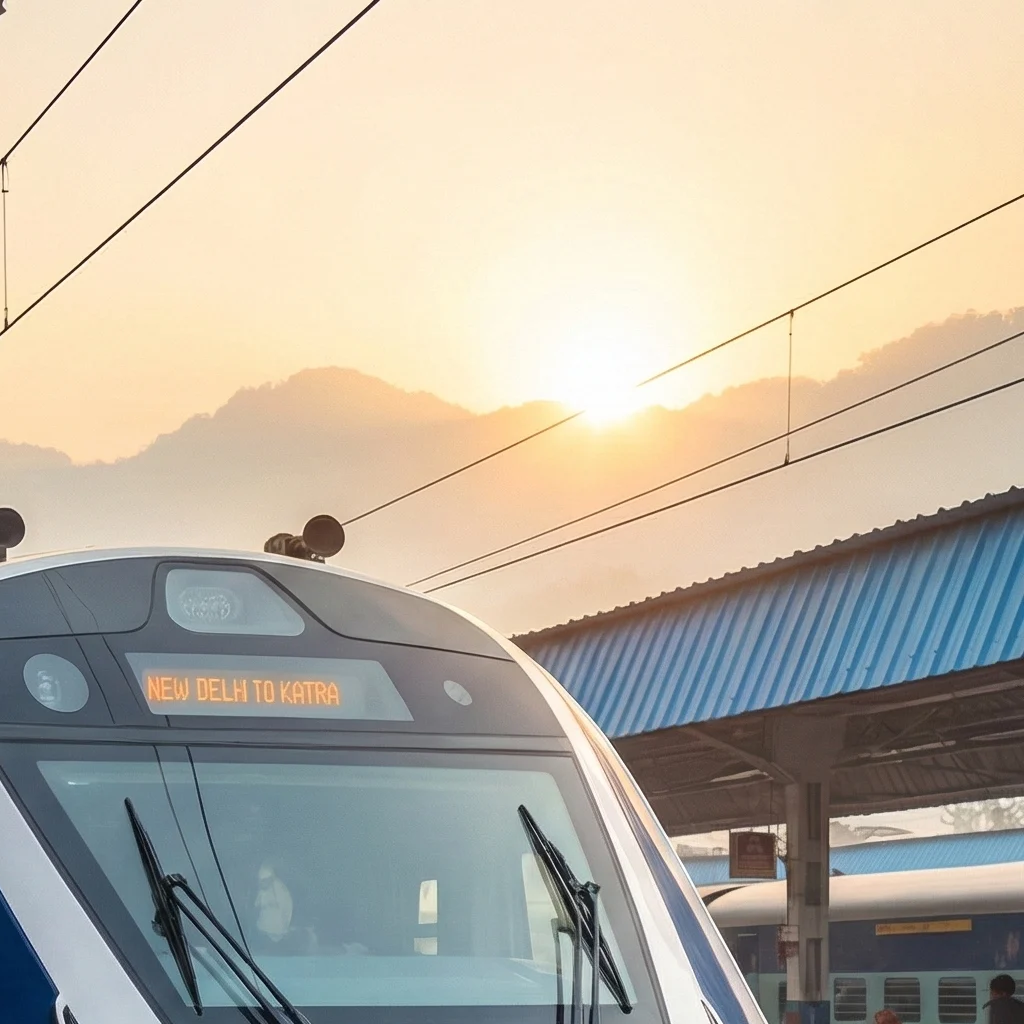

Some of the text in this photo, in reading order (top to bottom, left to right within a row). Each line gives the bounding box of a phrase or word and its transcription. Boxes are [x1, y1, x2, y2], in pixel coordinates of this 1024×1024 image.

[147, 676, 190, 701] NEW
[252, 679, 275, 703] TO
[279, 681, 340, 706] KATRA
